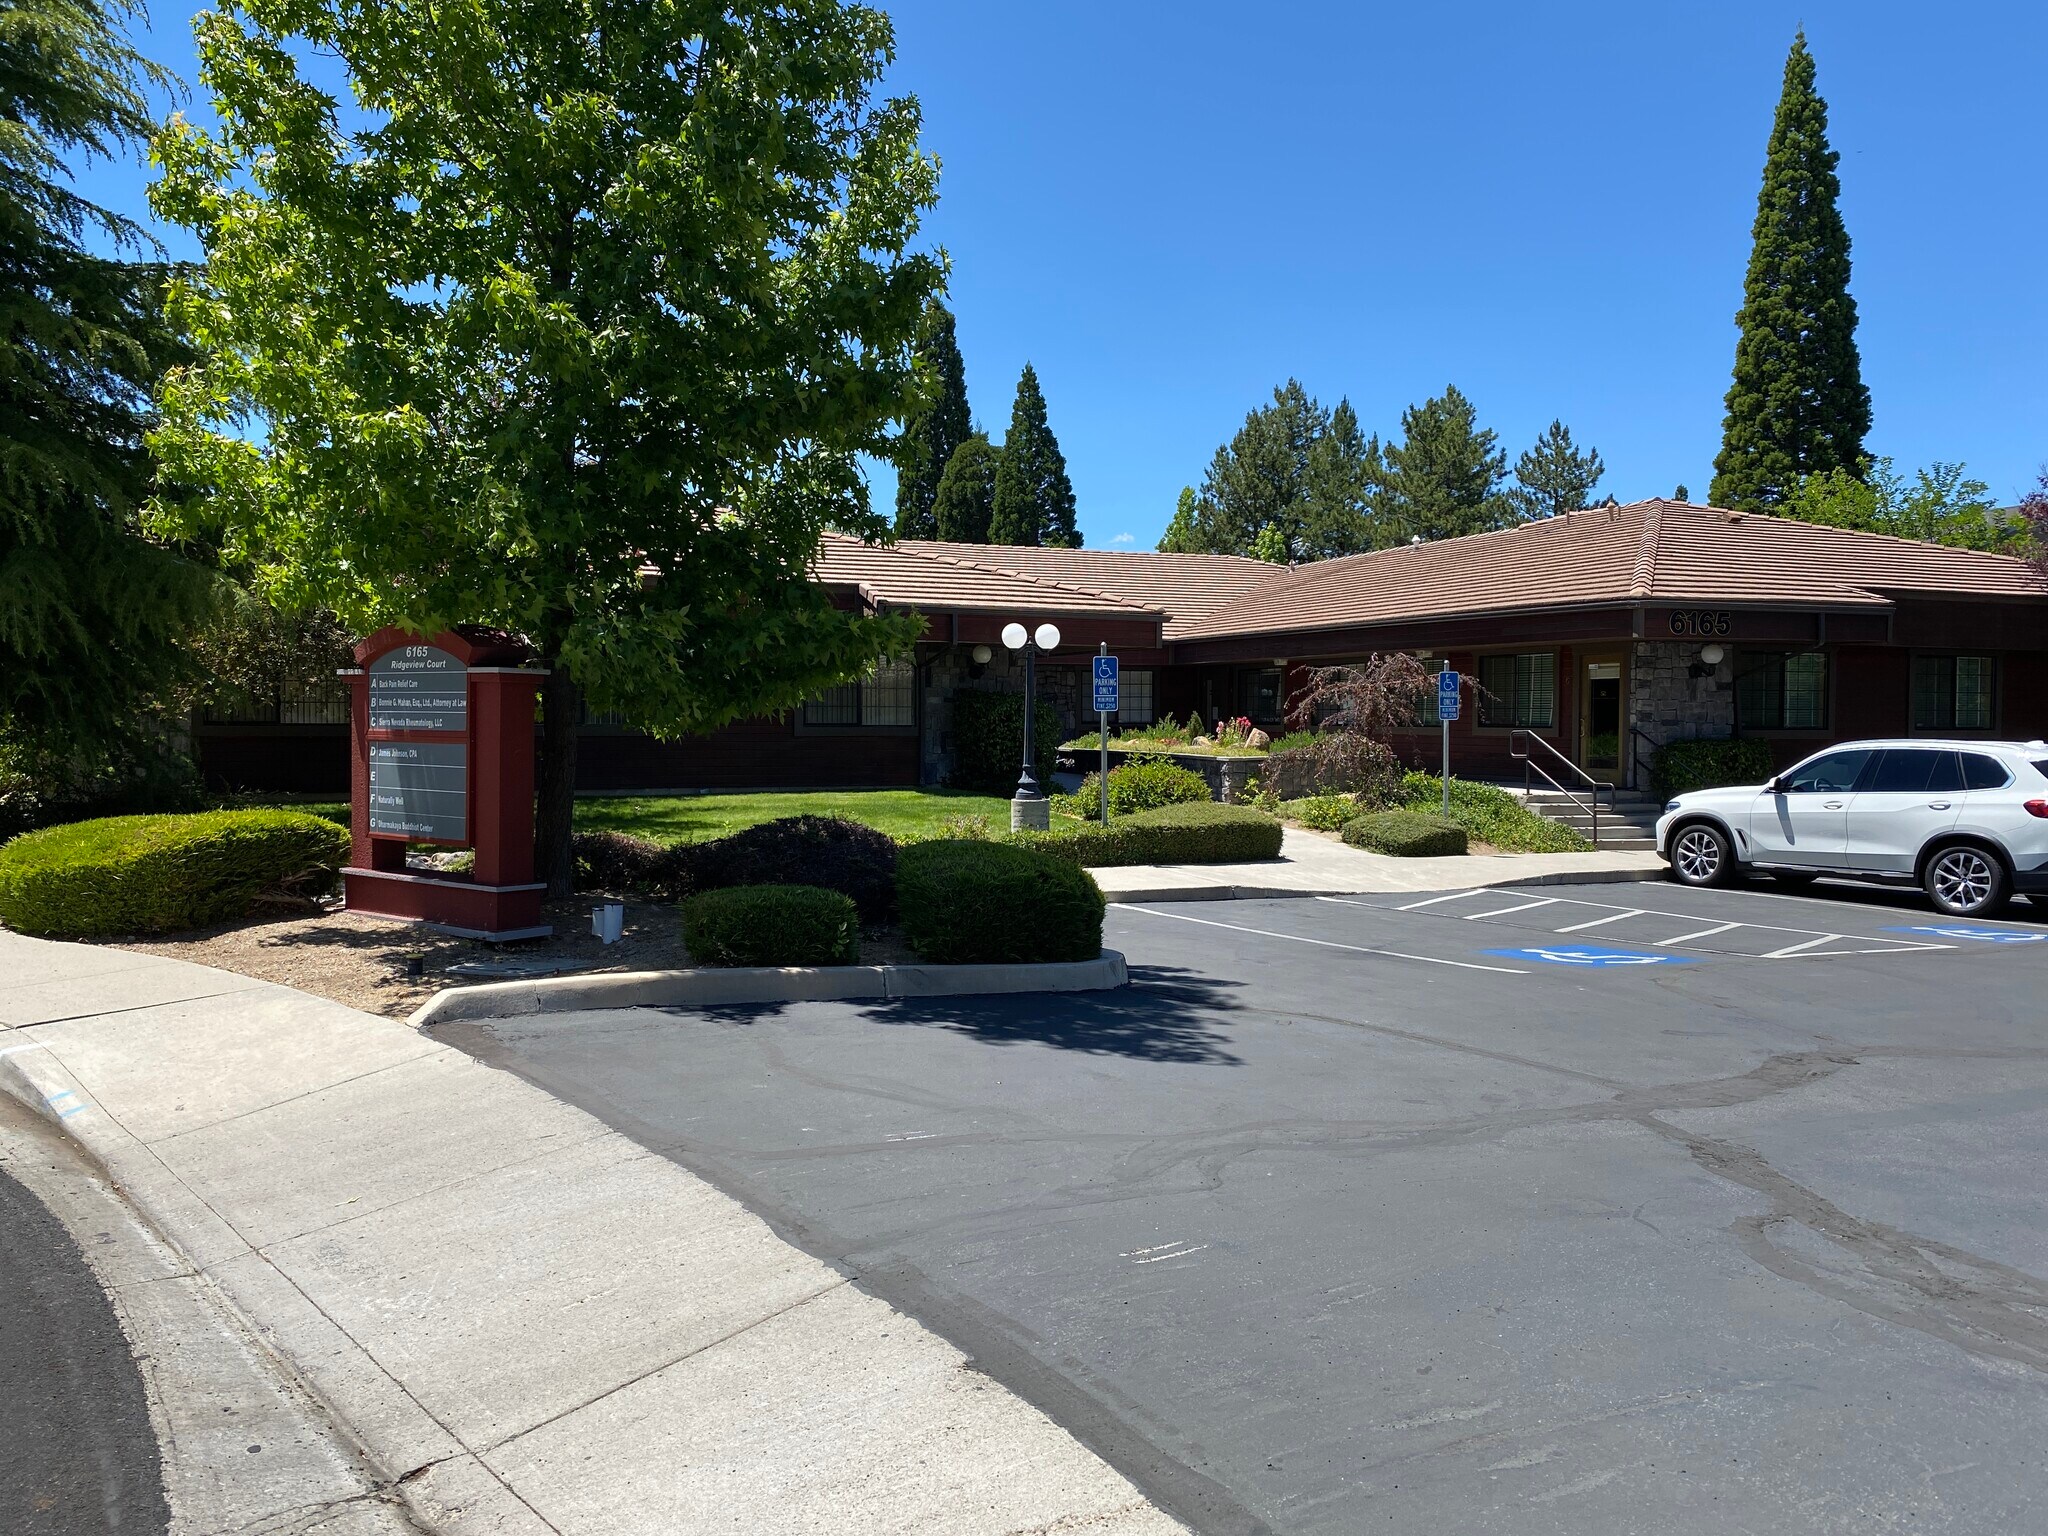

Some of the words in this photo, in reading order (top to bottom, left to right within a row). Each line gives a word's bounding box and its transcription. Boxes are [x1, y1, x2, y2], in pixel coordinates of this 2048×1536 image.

[1669, 610, 1732, 636] 6165
[406, 646, 428, 658] 6165
[391, 660, 425, 671] Ridgeview
[426, 659, 446, 669] Court
[371, 678, 376, 688] A
[379, 680, 388, 688] Back
[389, 680, 397, 688] Pain
[398, 680, 408, 688] Relief
[409, 680, 418, 688] Care
[1095, 678, 1116, 686] PARKING
[1099, 686, 1112, 694] ONLY
[371, 698, 376, 707] B
[433, 698, 451, 708] Attorney
[371, 717, 376, 727] C
[391, 718, 405, 726] Nevada
[434, 718, 442, 727] LLC
[370, 746, 376, 756] D
[379, 749, 390, 757] James
[409, 749, 418, 758] CPA
[370, 771, 376, 781] E
[370, 794, 376, 804] F
[379, 796, 395, 806] Naturally
[396, 796, 404, 805] Well
[370, 818, 376, 827] G
[402, 822, 419, 831] Buddhist
[420, 823, 433, 832] Center
